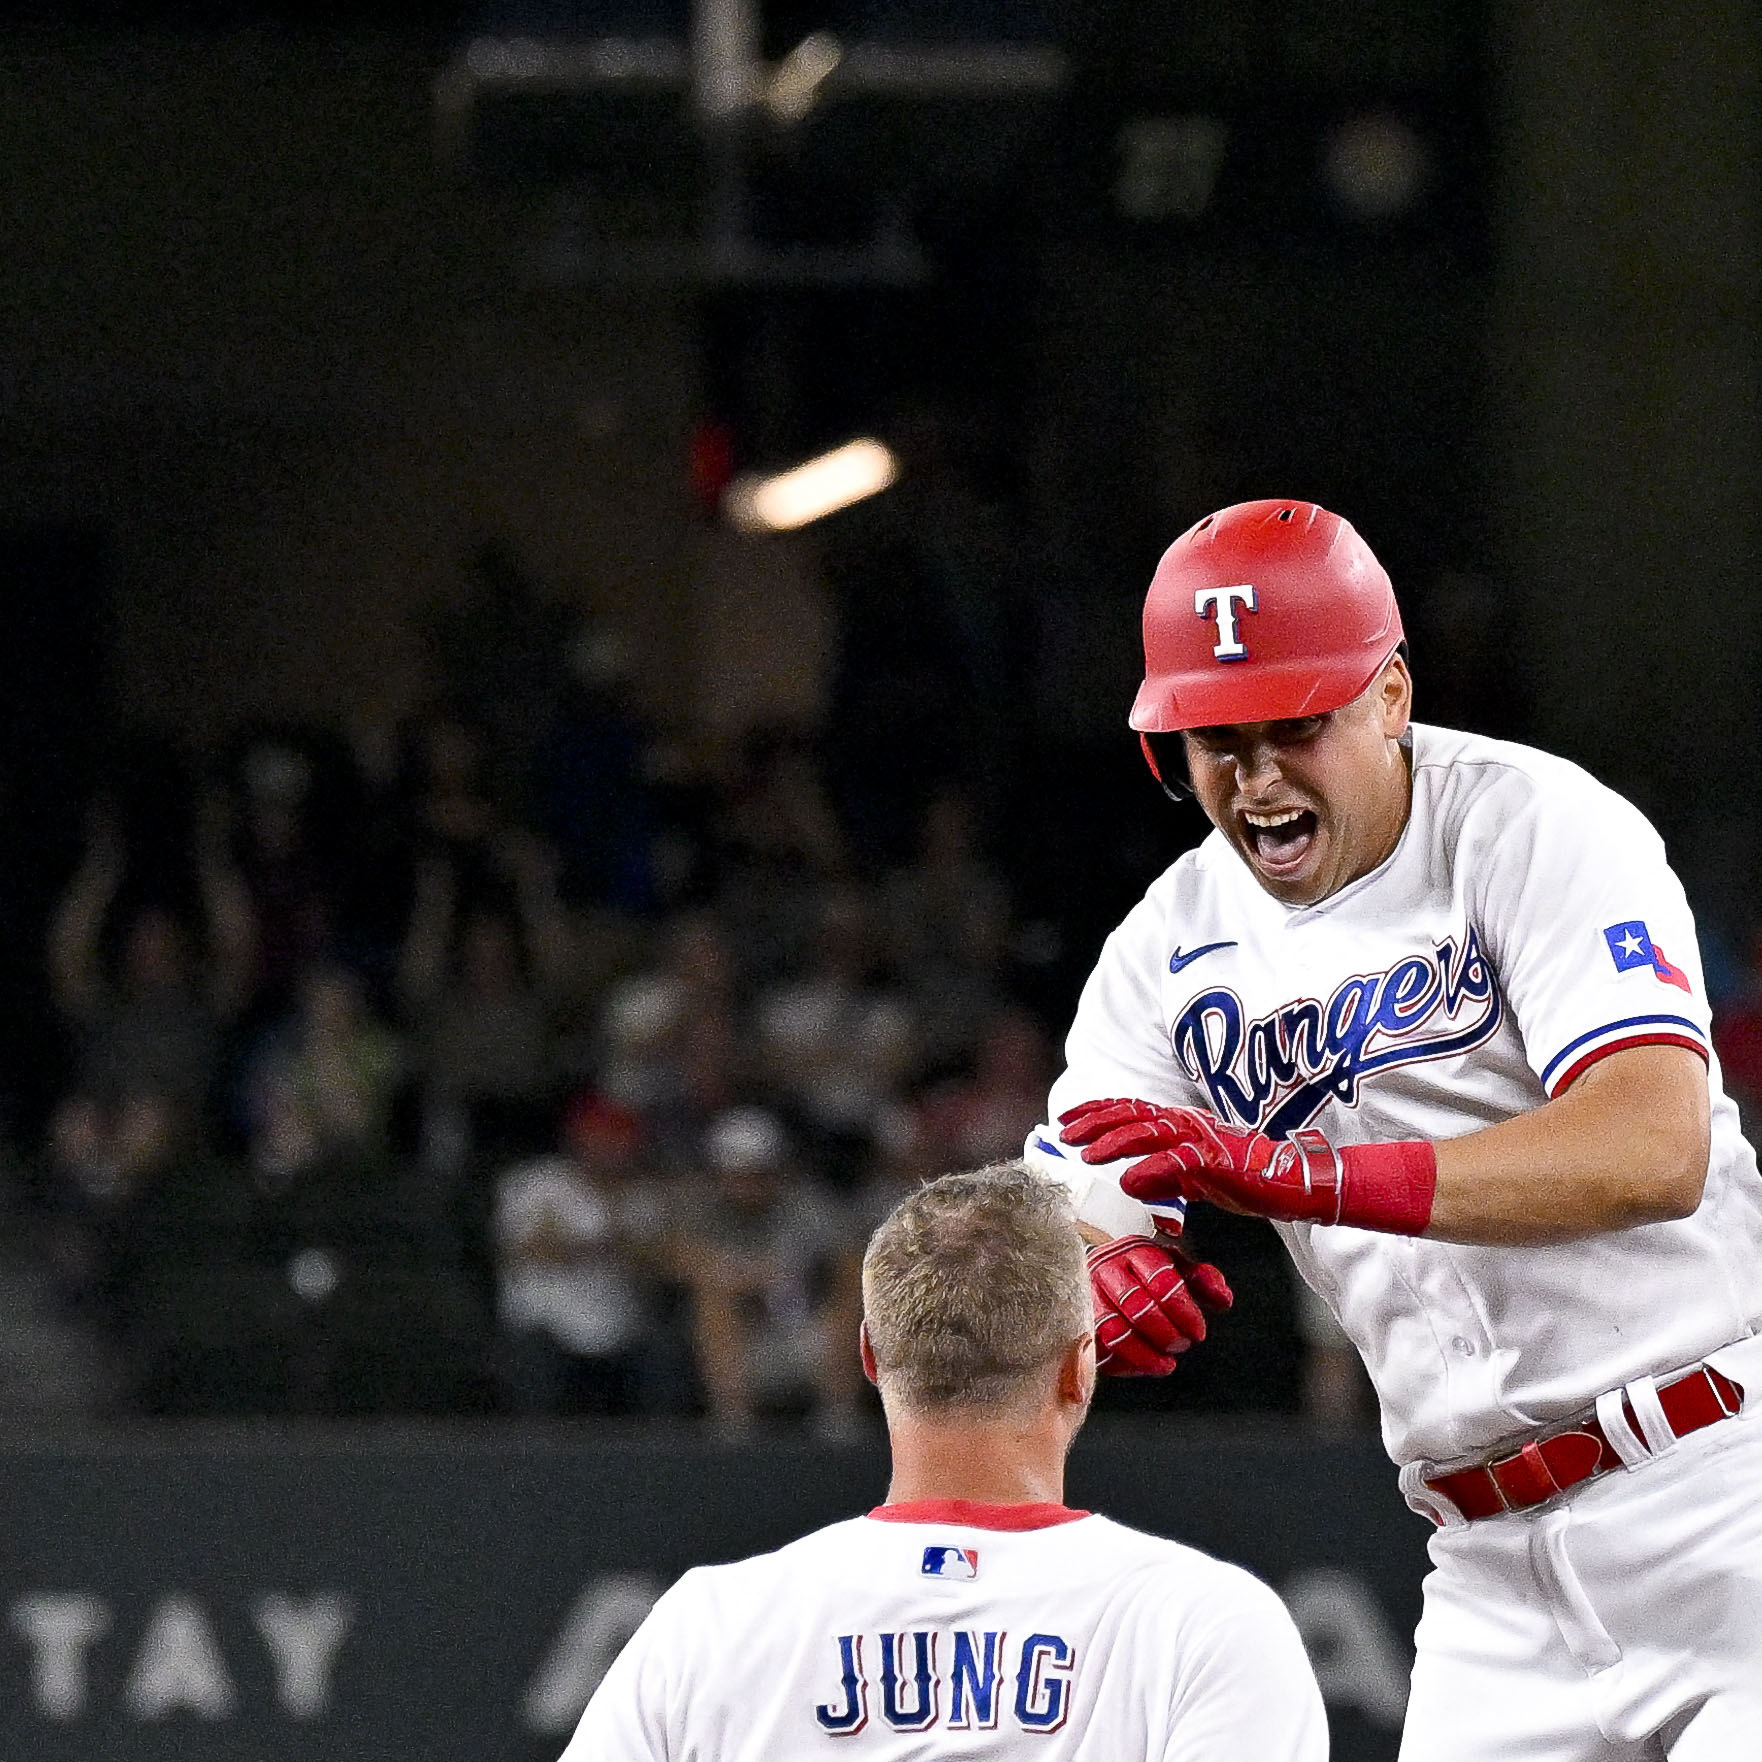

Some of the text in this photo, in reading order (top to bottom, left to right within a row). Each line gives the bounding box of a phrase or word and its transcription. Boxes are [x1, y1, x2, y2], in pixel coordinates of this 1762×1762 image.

[1194, 583, 1258, 662] T
[1168, 918, 1503, 1140] Rangers
[815, 1630, 1077, 1737] JUNG
